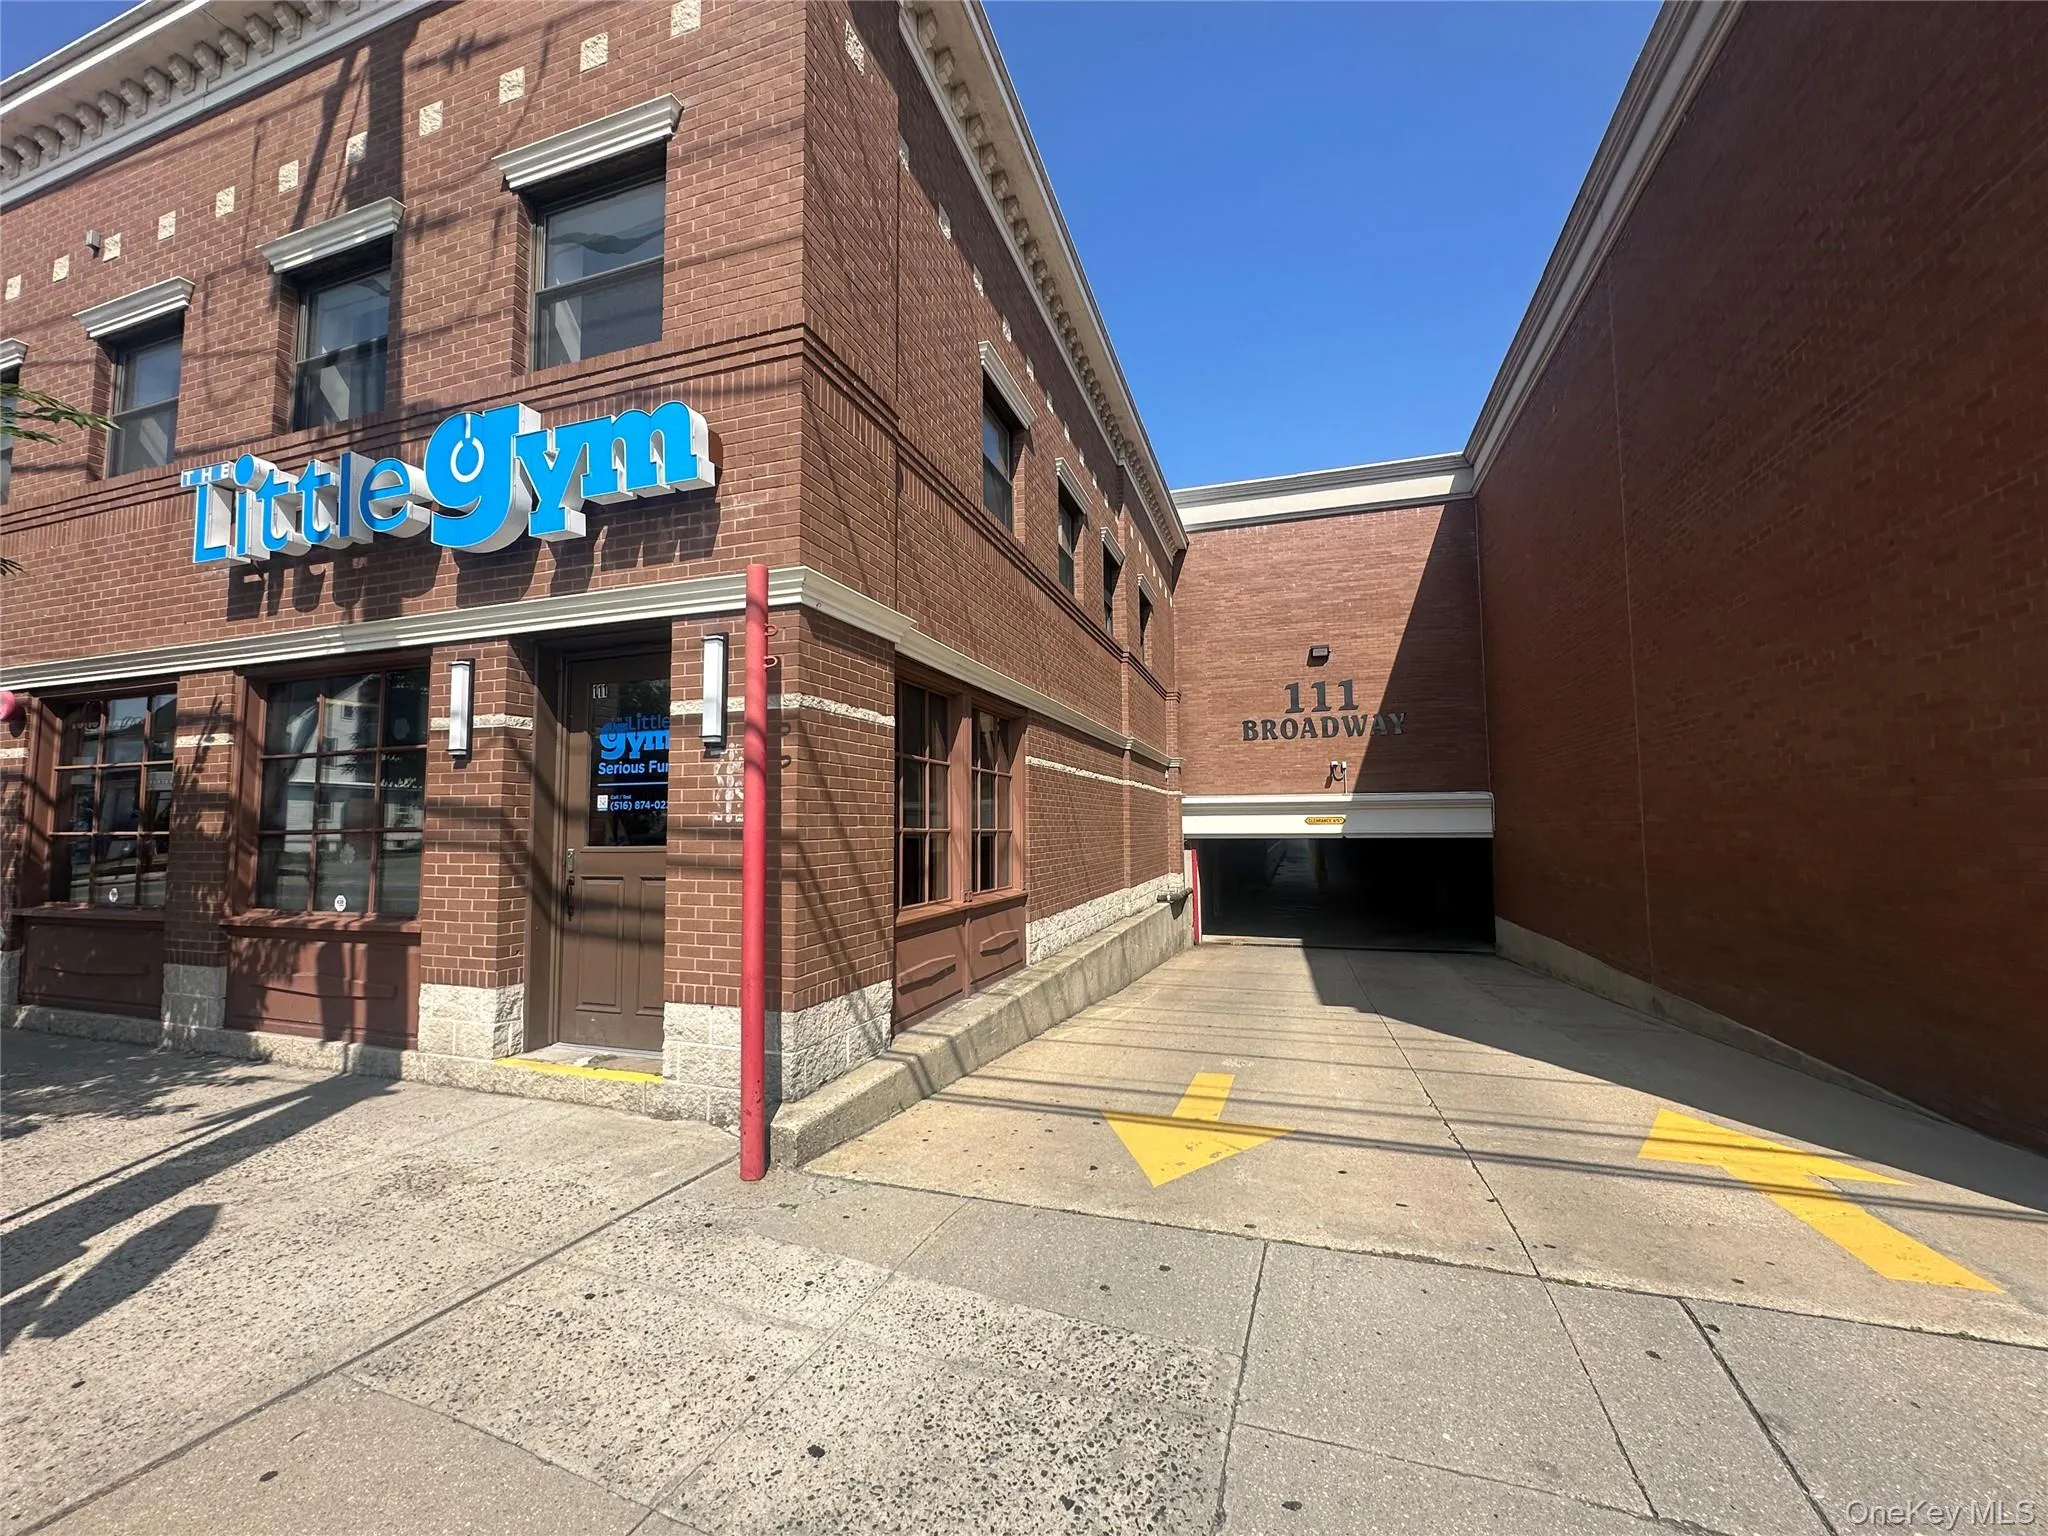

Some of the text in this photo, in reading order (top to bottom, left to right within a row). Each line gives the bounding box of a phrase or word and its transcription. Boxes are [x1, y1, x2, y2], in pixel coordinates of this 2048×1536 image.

[182, 462, 230, 486] THE
[193, 401, 716, 566] Little gym
[1285, 679, 1358, 713] 111
[628, 712, 670, 731] Little
[1242, 712, 1406, 741] BROADWAY
[599, 721, 670, 760] gym
[598, 761, 645, 775] Serious
[610, 800, 669, 811] (516) 874-02
